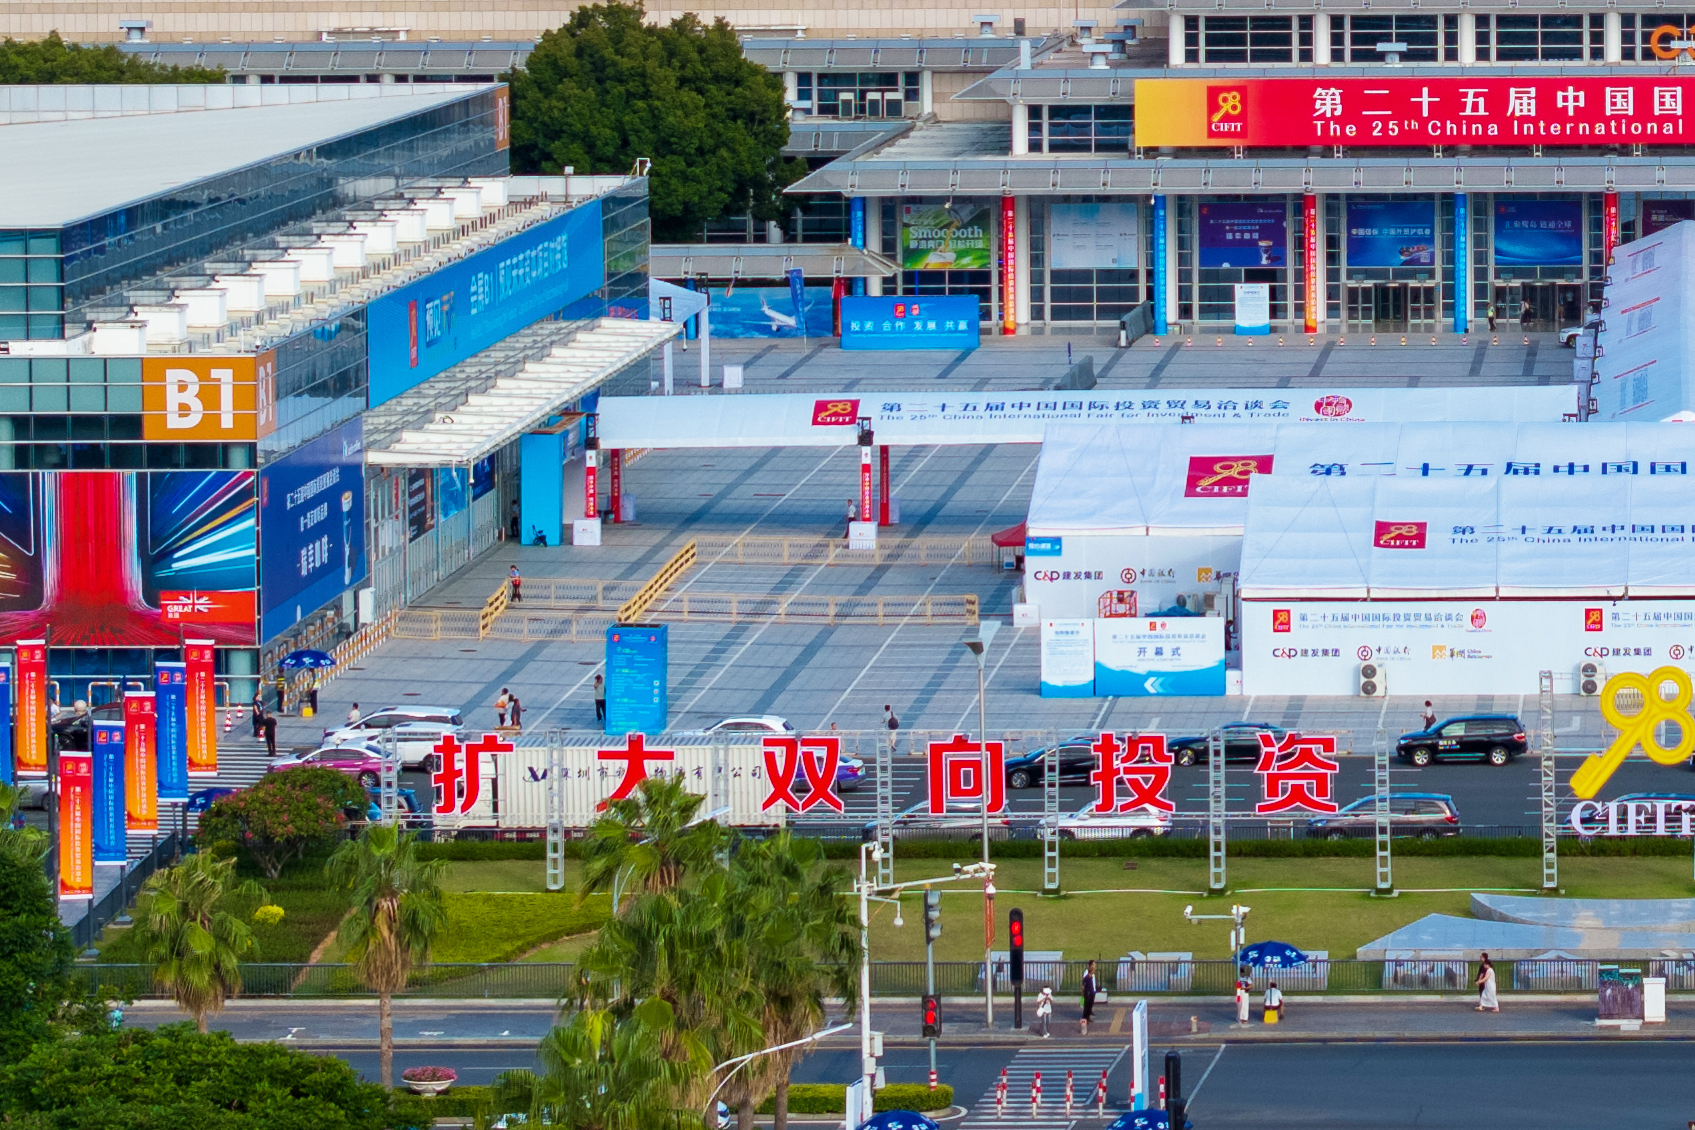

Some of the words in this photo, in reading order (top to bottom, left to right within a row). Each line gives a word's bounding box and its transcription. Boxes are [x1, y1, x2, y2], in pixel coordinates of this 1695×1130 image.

[1211, 122, 1243, 133] CIFIT
[1313, 120, 1357, 137] The
[1372, 120, 1419, 137] 25th
[1427, 119, 1499, 136] China
[1513, 119, 1683, 136] International
[882, 320, 905, 332] 合作
[166, 368, 234, 429] B1
[259, 362, 273, 426] B1
[880, 399, 1291, 412] 第二十五届中国国际投资贸易洽谈会
[1034, 570, 1060, 583] C&D
[1062, 571, 1104, 581] 建发集团
[1299, 612, 1464, 623] 第二十五届中国国际投资贸易洽谈会
[1137, 646, 1182, 657] 开幕式
[1272, 647, 1298, 659] C&D
[1300, 648, 1341, 658] 建发集团
[1584, 646, 1610, 658] C&D
[1612, 647, 1652, 657] 建发集团
[431, 730, 1340, 816] 扩大双向投资
